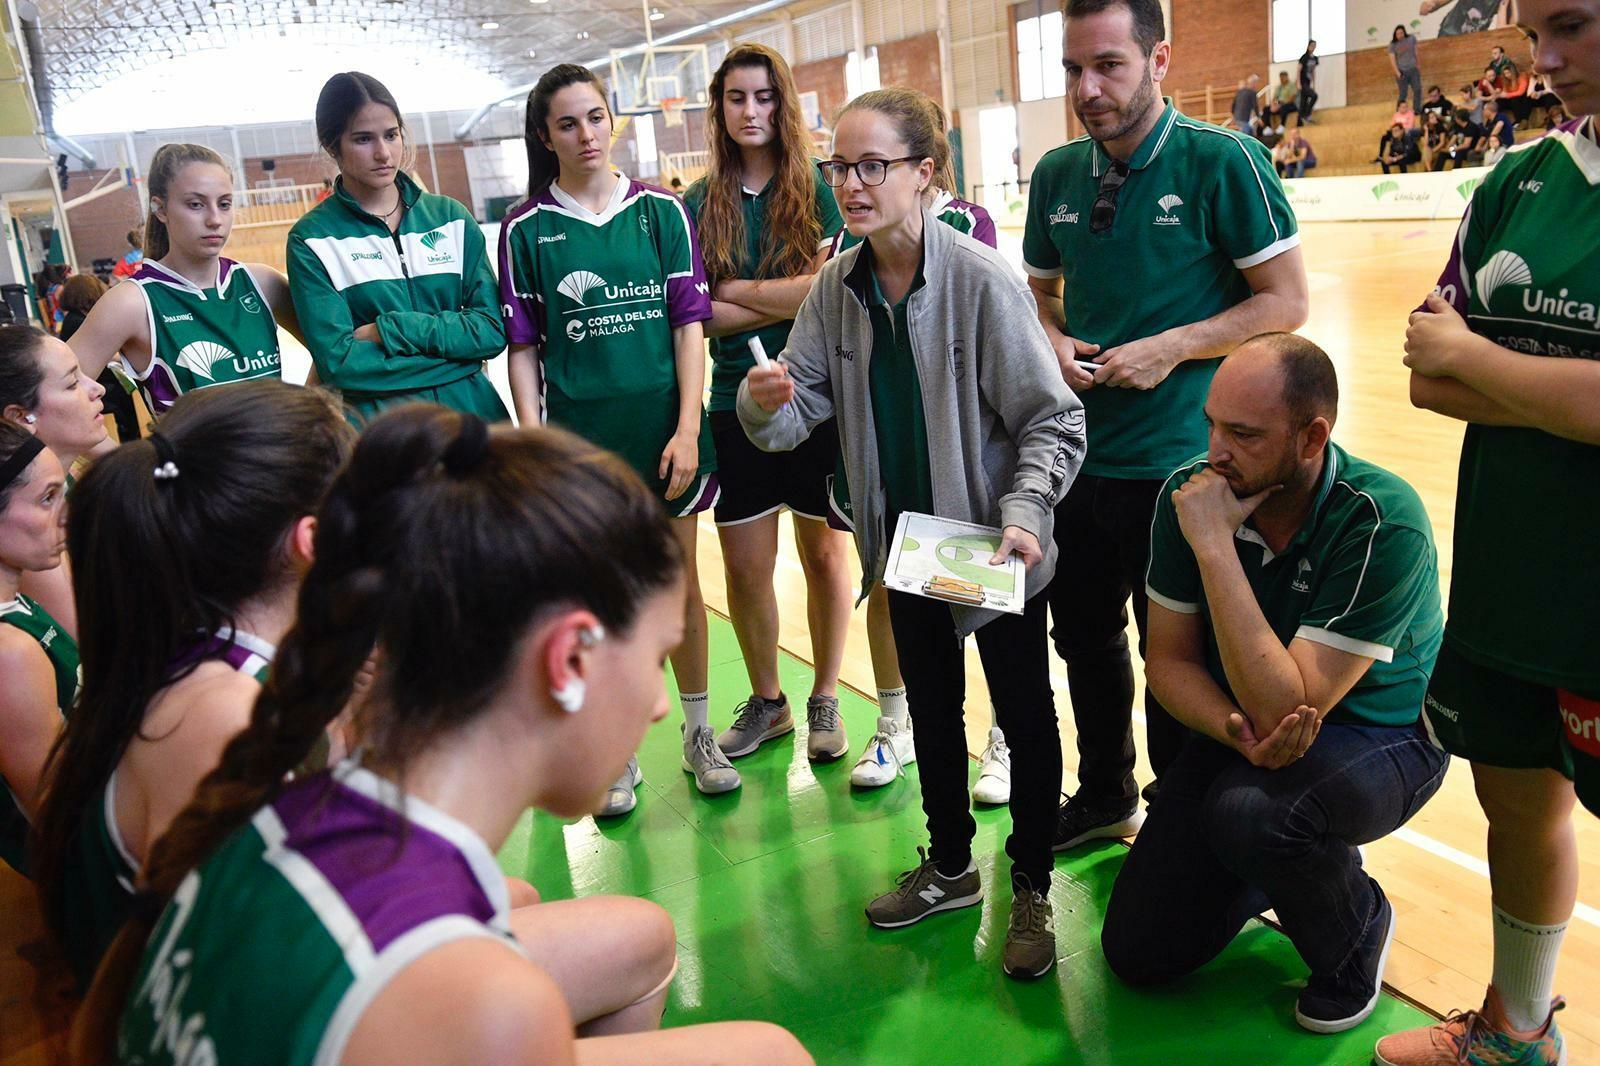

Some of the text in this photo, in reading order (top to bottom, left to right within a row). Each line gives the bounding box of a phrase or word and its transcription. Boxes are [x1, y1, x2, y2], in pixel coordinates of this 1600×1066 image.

[1049, 212, 1079, 225] SPALDING
[1156, 214, 1180, 224] Unicaja
[537, 232, 567, 245] SPALDING
[351, 250, 383, 262] SPALDING
[427, 251, 453, 263] Unicaja
[604, 278, 662, 300] Unicaja
[163, 312, 194, 323] SPALDING
[587, 308, 664, 328] COSTA DEL SOL
[589, 323, 635, 338] MÁLAGA
[233, 346, 280, 373] Unica
[1426, 693, 1459, 723] SPALDING
